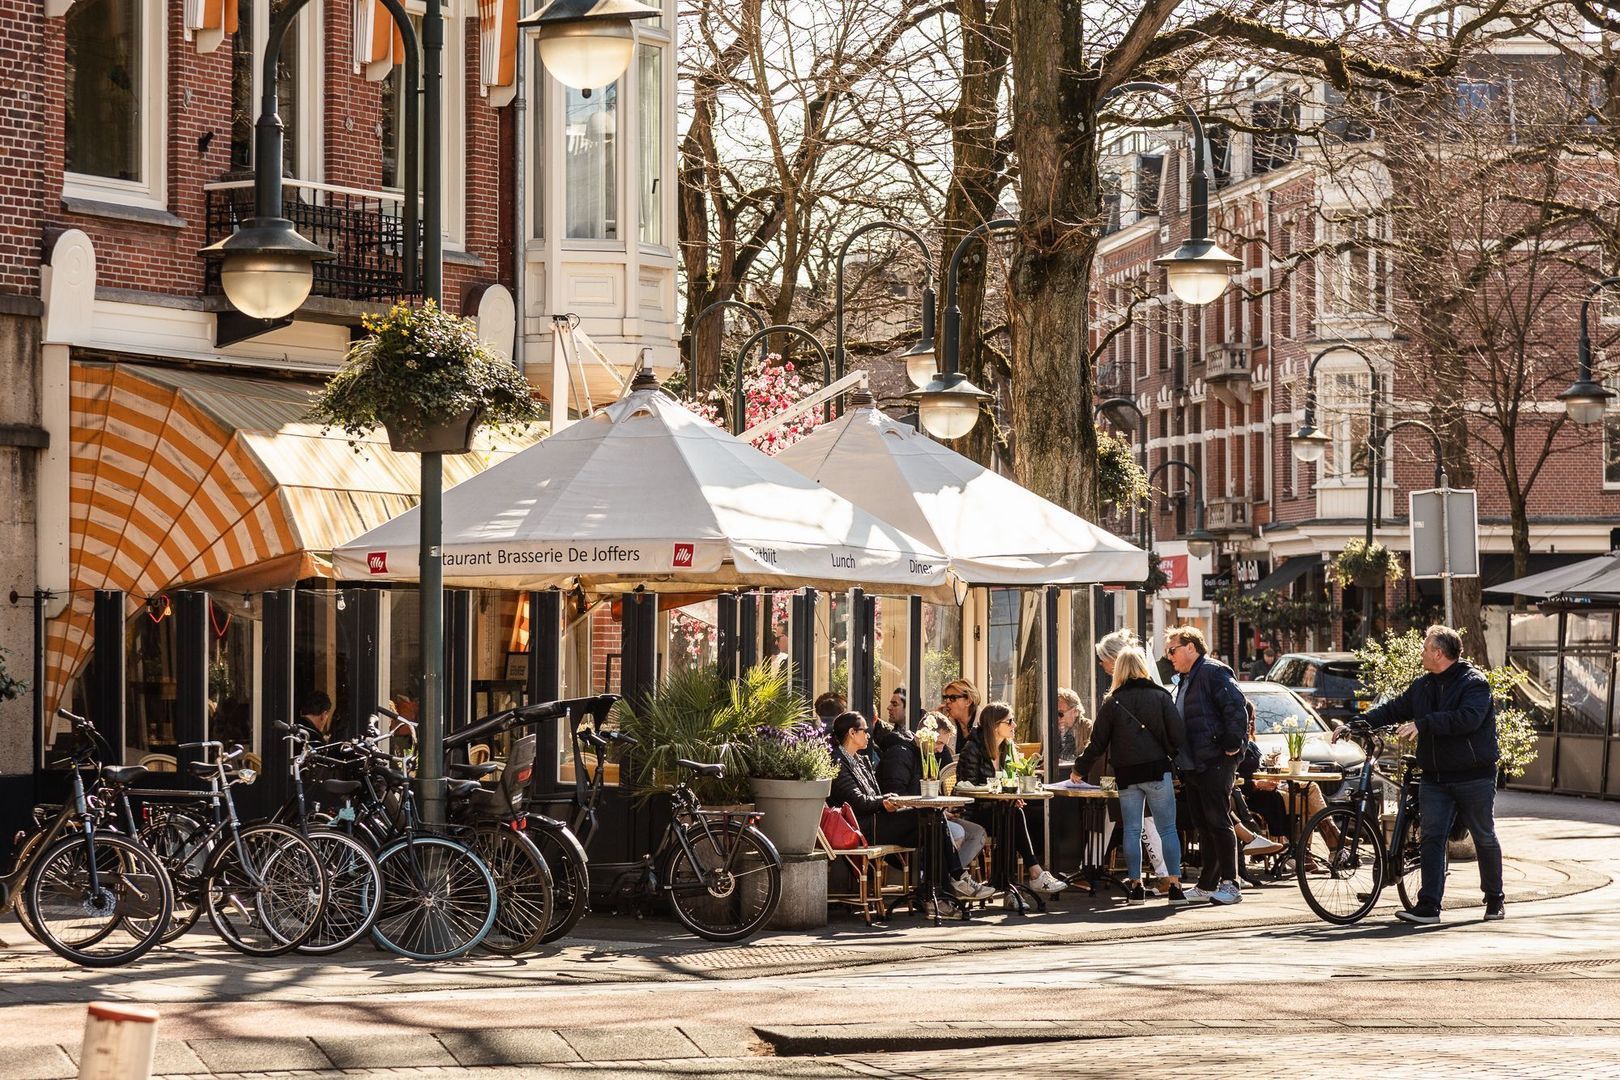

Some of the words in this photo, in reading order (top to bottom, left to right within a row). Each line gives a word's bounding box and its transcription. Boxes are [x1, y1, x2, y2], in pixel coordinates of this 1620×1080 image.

[497, 548, 563, 564] Brasserie
[568, 547, 588, 562] De
[592, 545, 640, 562] Joffers
[675, 547, 691, 564] illy
[831, 552, 856, 569] Lunch
[370, 556, 384, 571] illy
